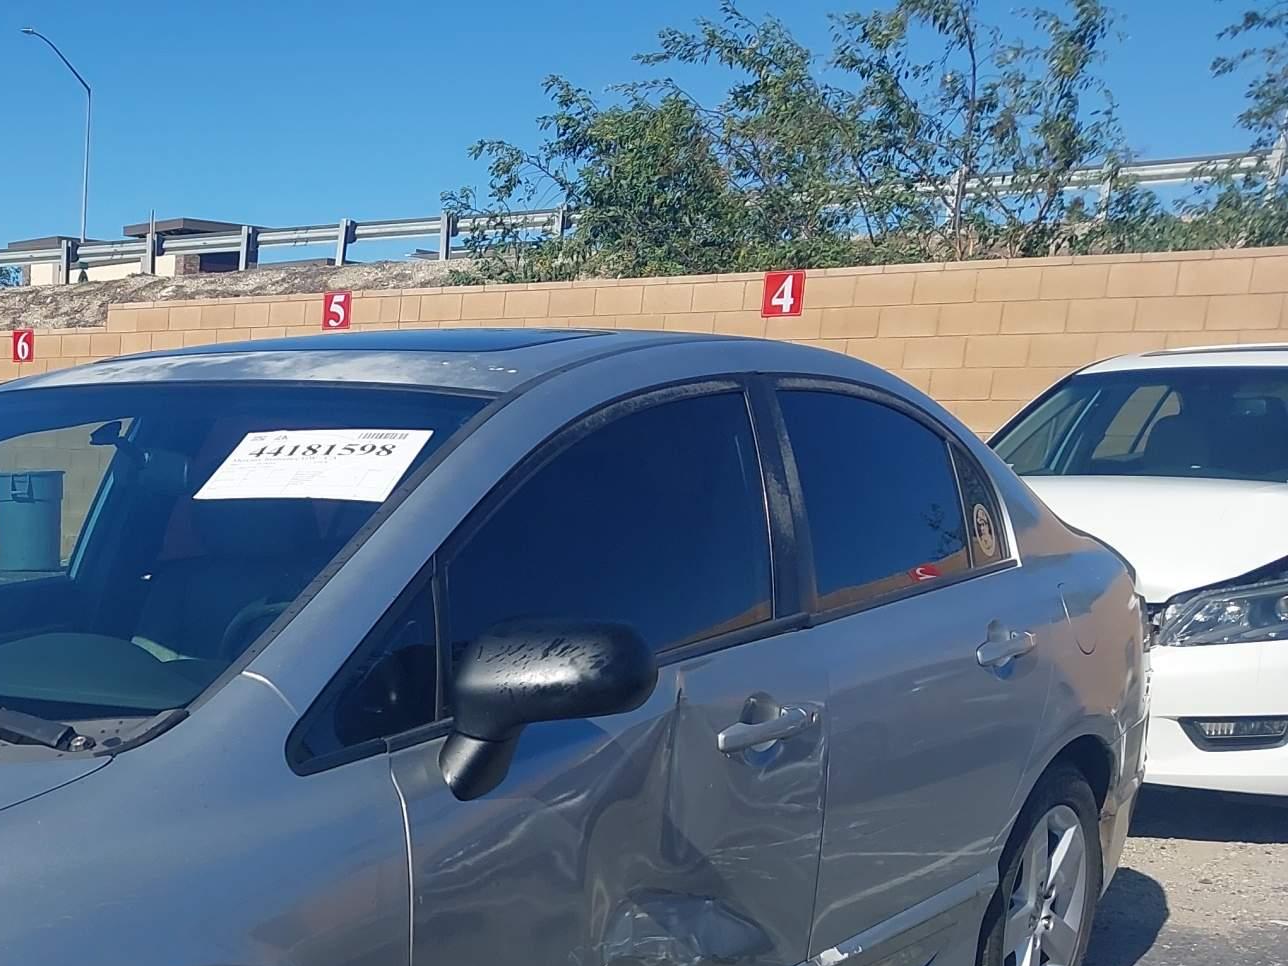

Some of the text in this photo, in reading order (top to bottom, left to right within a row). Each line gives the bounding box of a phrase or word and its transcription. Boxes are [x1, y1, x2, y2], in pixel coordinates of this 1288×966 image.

[771, 274, 794, 313] 4
[328, 294, 345, 327] 5
[17, 332, 29, 360] 6
[248, 443, 396, 458] 44181598
